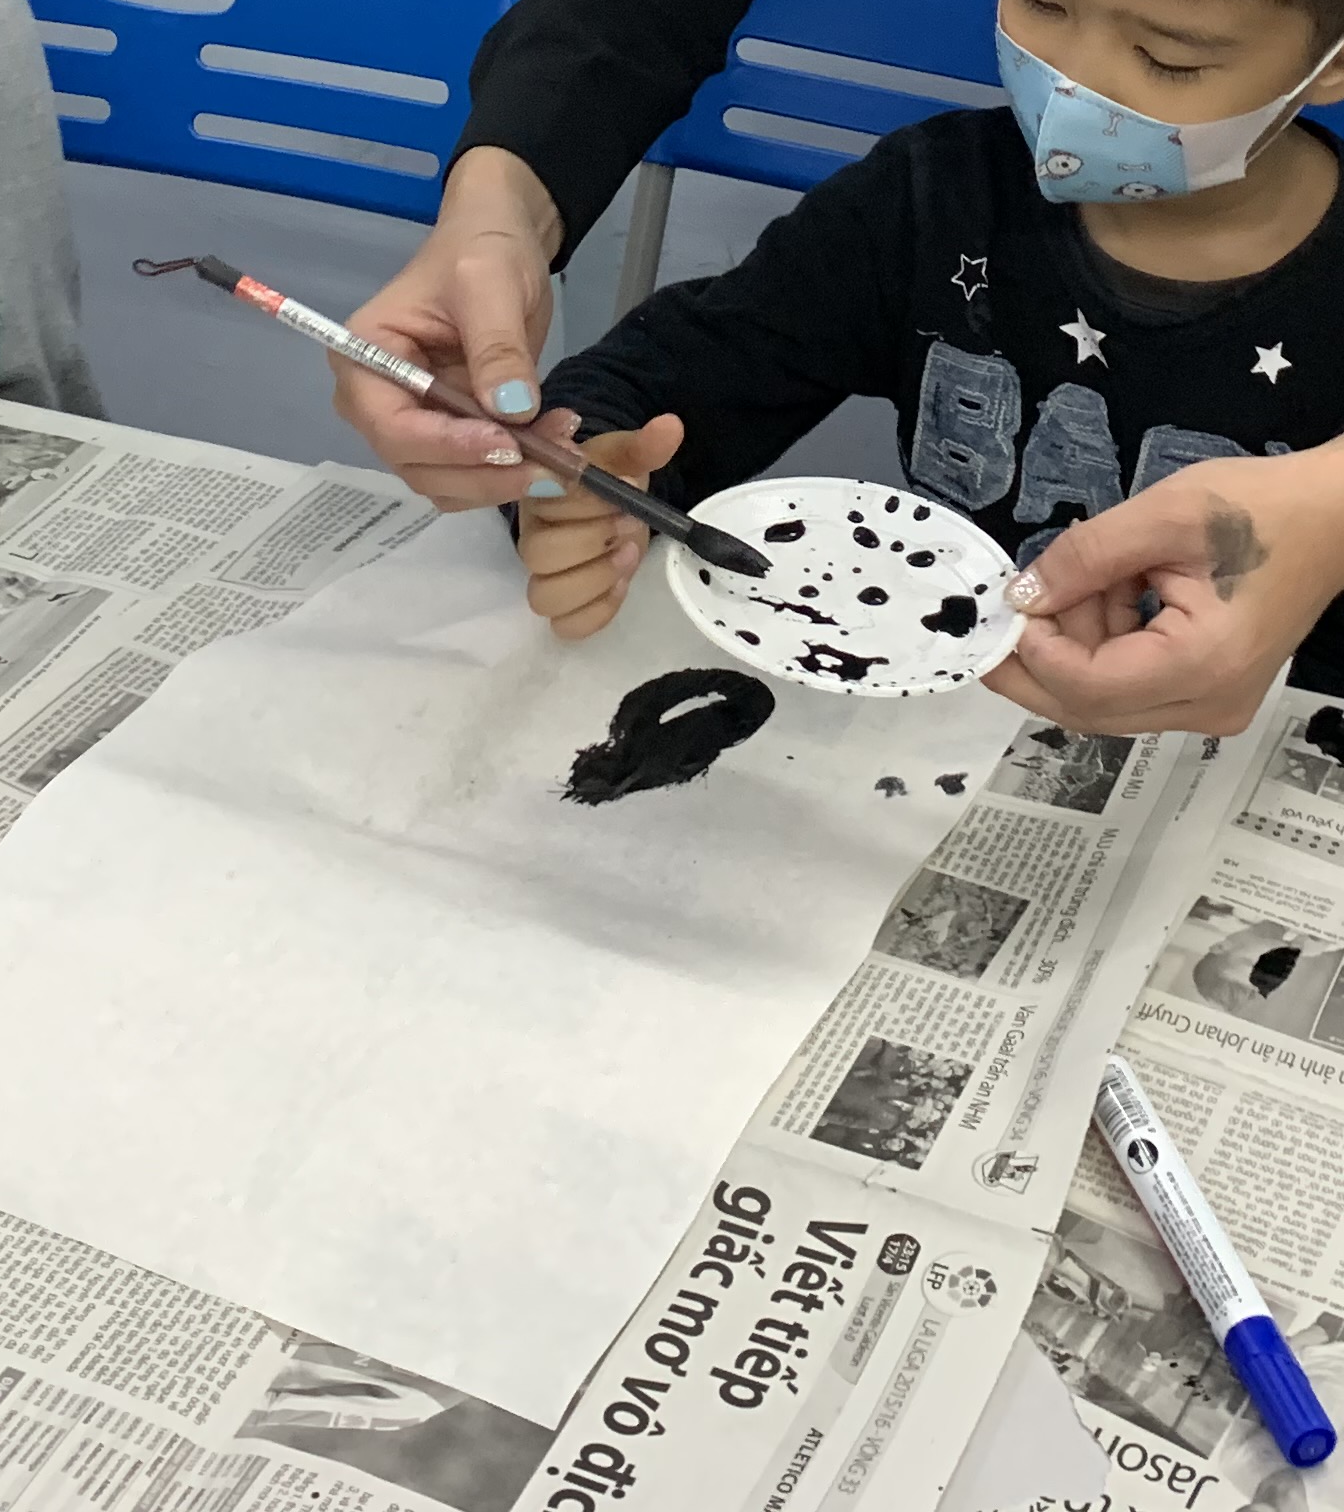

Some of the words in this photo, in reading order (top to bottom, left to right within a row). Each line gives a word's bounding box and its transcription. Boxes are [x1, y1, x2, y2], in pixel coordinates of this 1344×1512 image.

[1010, 1002, 1036, 1029] Van
[1135, 995, 1195, 1036] Cruyff
[996, 1027, 1025, 1059] Gaal
[1189, 1018, 1250, 1056] Johan
[1273, 1047, 1299, 1072] tri
[975, 1080, 995, 1098] an
[956, 1095, 990, 1132] NHM
[676, 1178, 796, 1295] giấc
[878, 1237, 903, 1266] 17/4
[769, 1208, 876, 1321] Viết
[892, 1239, 918, 1273] 23:15
[921, 1260, 949, 1291] LFP
[636, 1286, 719, 1376] mơ
[917, 1317, 942, 1339] LA
[698, 1306, 823, 1421] tiếp
[901, 1337, 932, 1373] LIGA
[597, 1371, 682, 1445] vô
[873, 1370, 916, 1430] 2015/16
[774, 1425, 825, 1497] ATLETICO
[835, 1475, 861, 1496] 33
